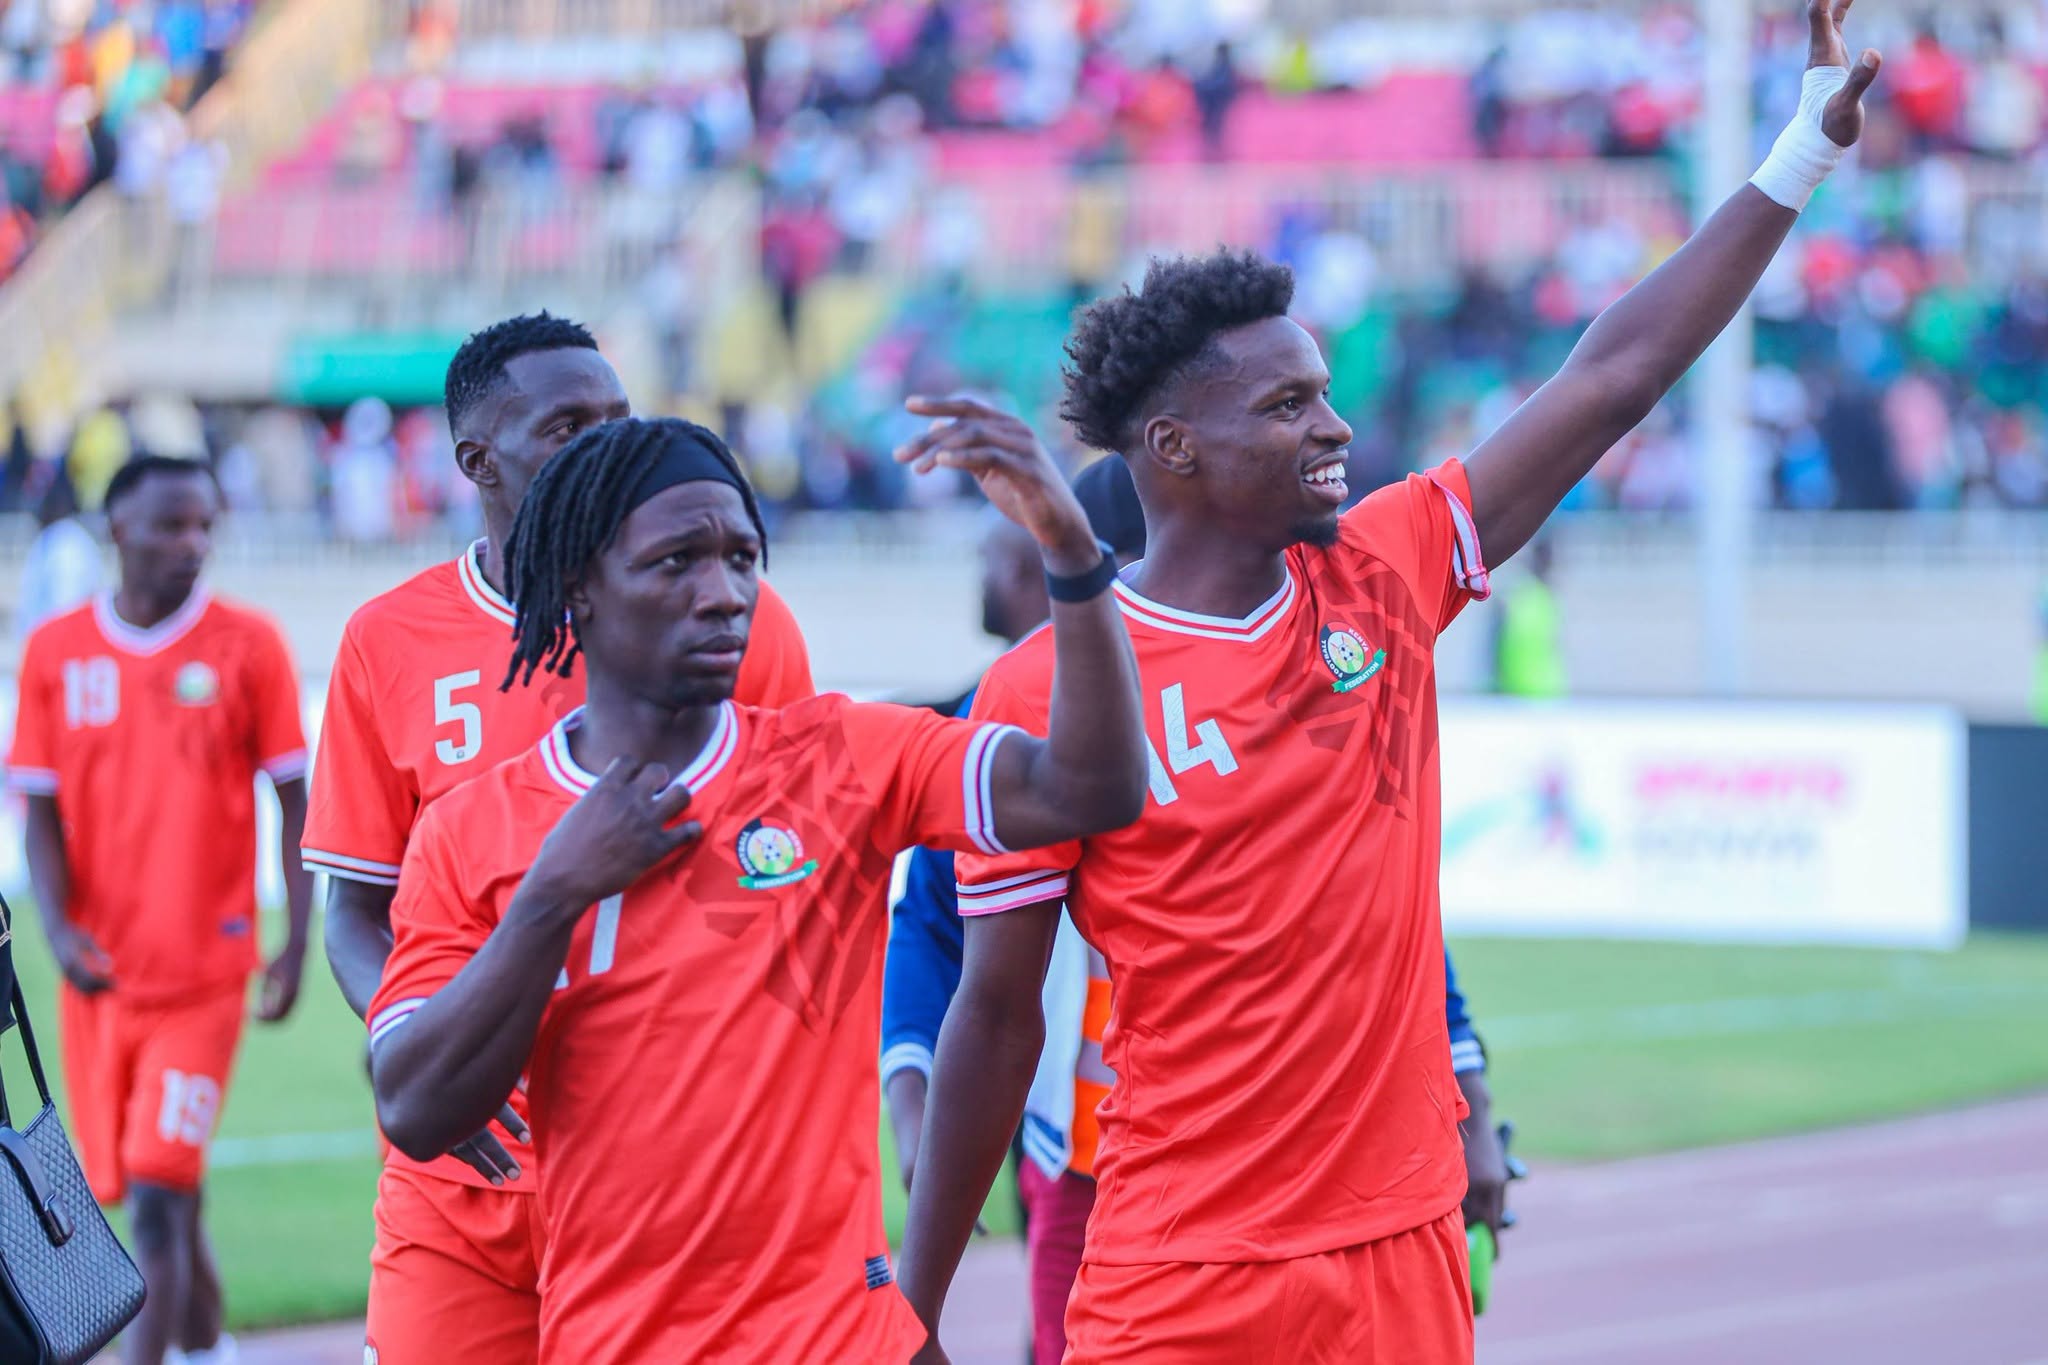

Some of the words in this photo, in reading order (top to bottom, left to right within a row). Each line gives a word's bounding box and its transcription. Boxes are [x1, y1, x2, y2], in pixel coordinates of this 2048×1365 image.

[1321, 640, 1343, 678] FOOTBALL
[1348, 627, 1369, 653] KENYA
[64, 655, 120, 730] 19
[1344, 661, 1379, 690] FEDERATION
[434, 668, 482, 765] 5
[738, 831, 757, 876] FOOTBALL
[754, 870, 806, 889] FEDERATION
[158, 1068, 219, 1146] 19
